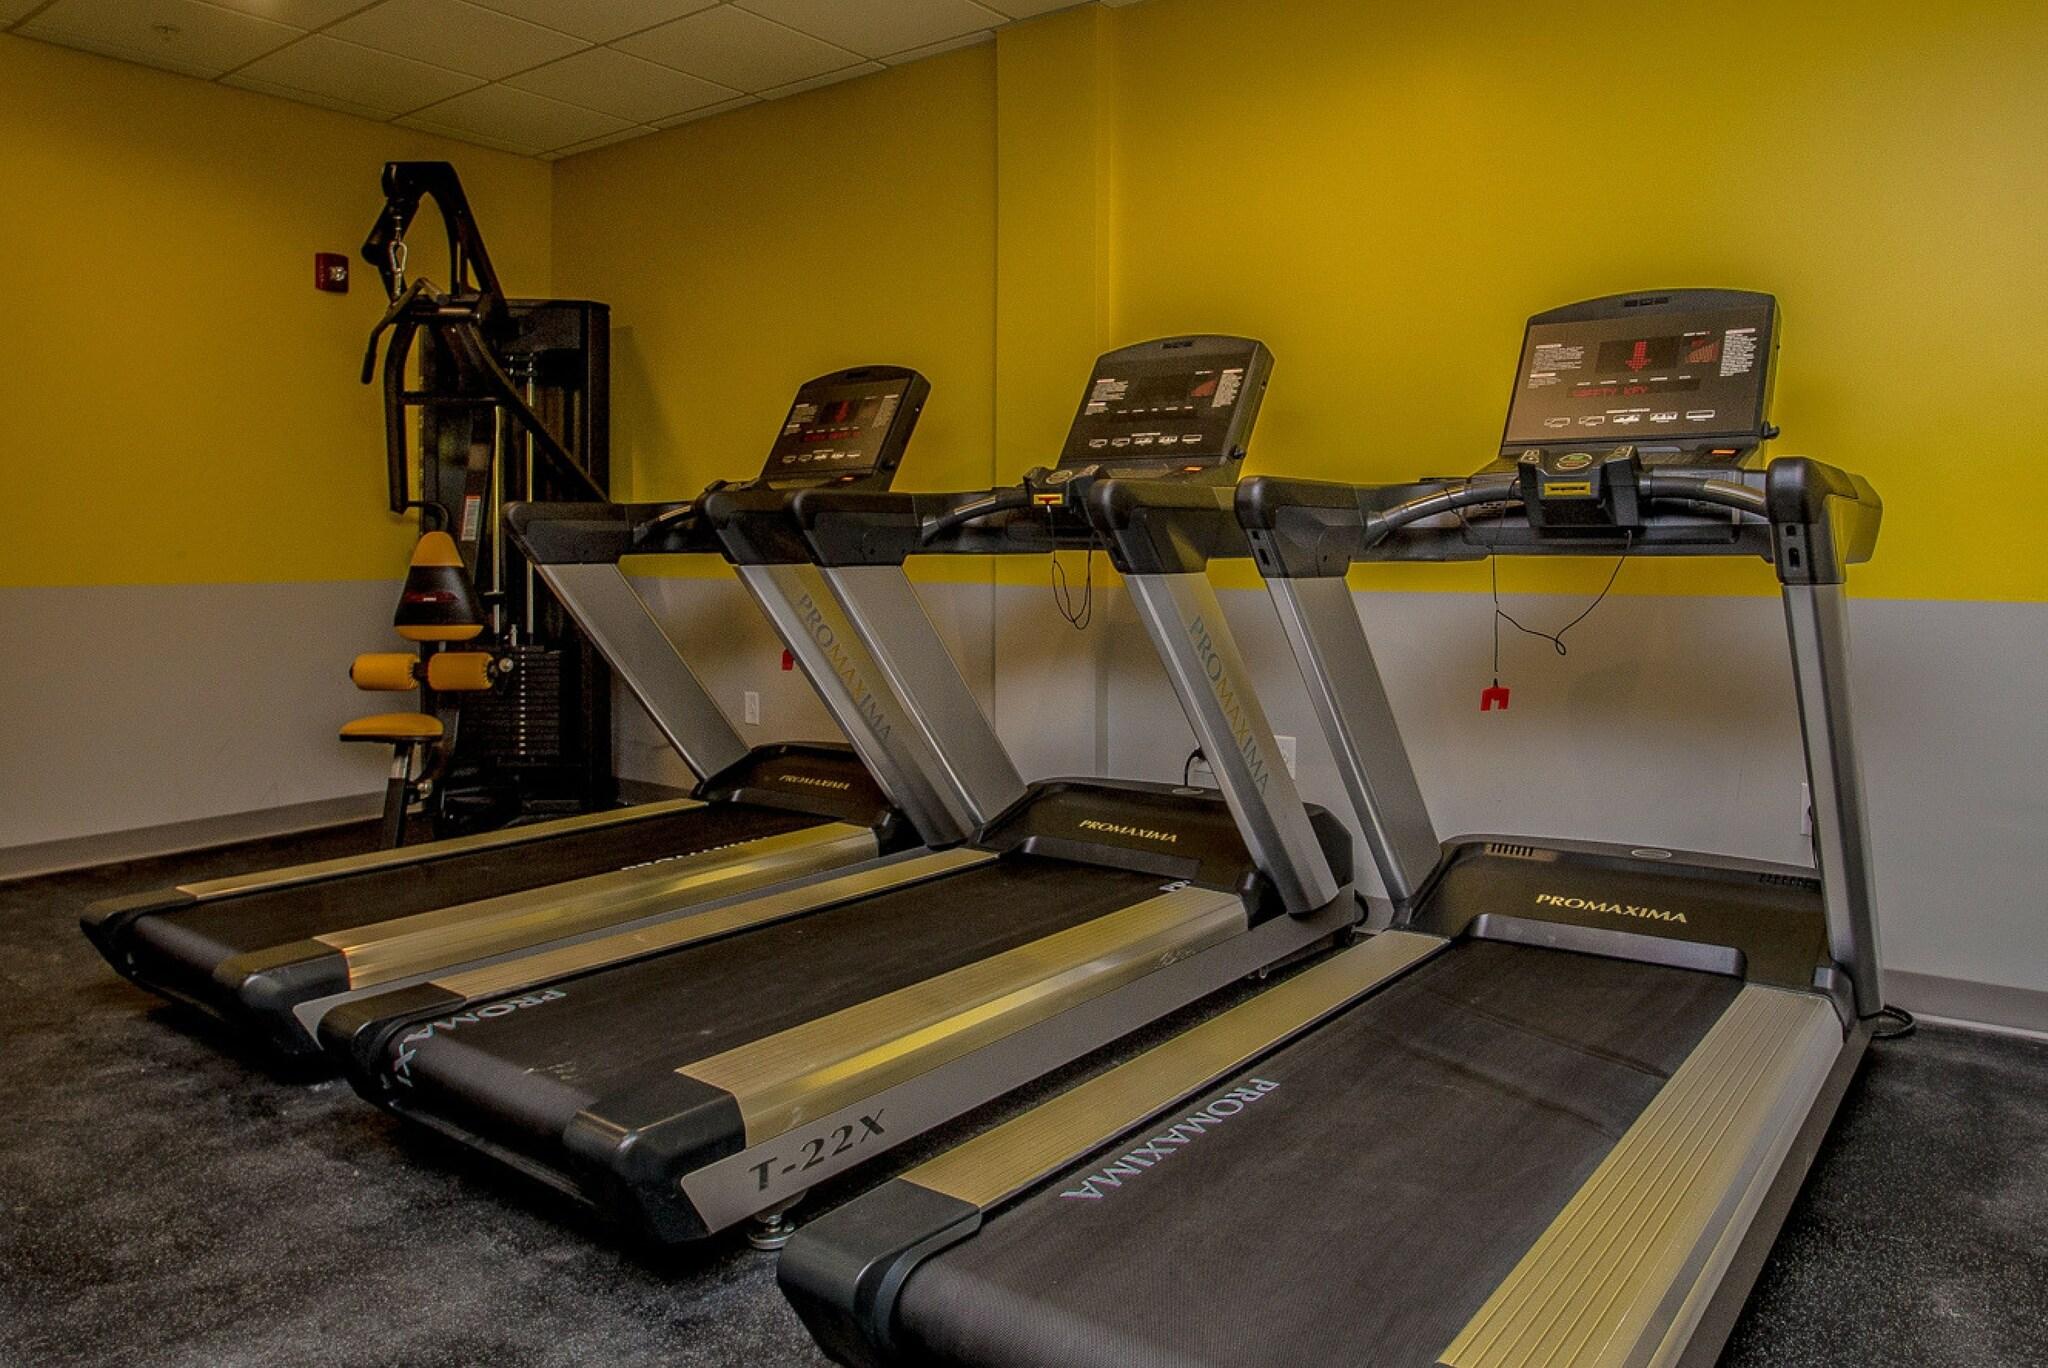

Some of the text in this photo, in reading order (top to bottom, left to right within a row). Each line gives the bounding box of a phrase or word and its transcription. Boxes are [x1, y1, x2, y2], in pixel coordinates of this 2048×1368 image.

[800, 593, 891, 740] PROMAXIMA
[1190, 616, 1269, 794] PROMAXIMA
[1078, 819, 1178, 843] PROMAXIMA
[1535, 893, 1688, 924] PROMAXIMA
[394, 988, 567, 1088] PROMAXI
[748, 1108, 885, 1191] T-22X
[1059, 1078, 1280, 1200] PROMAXIMA
